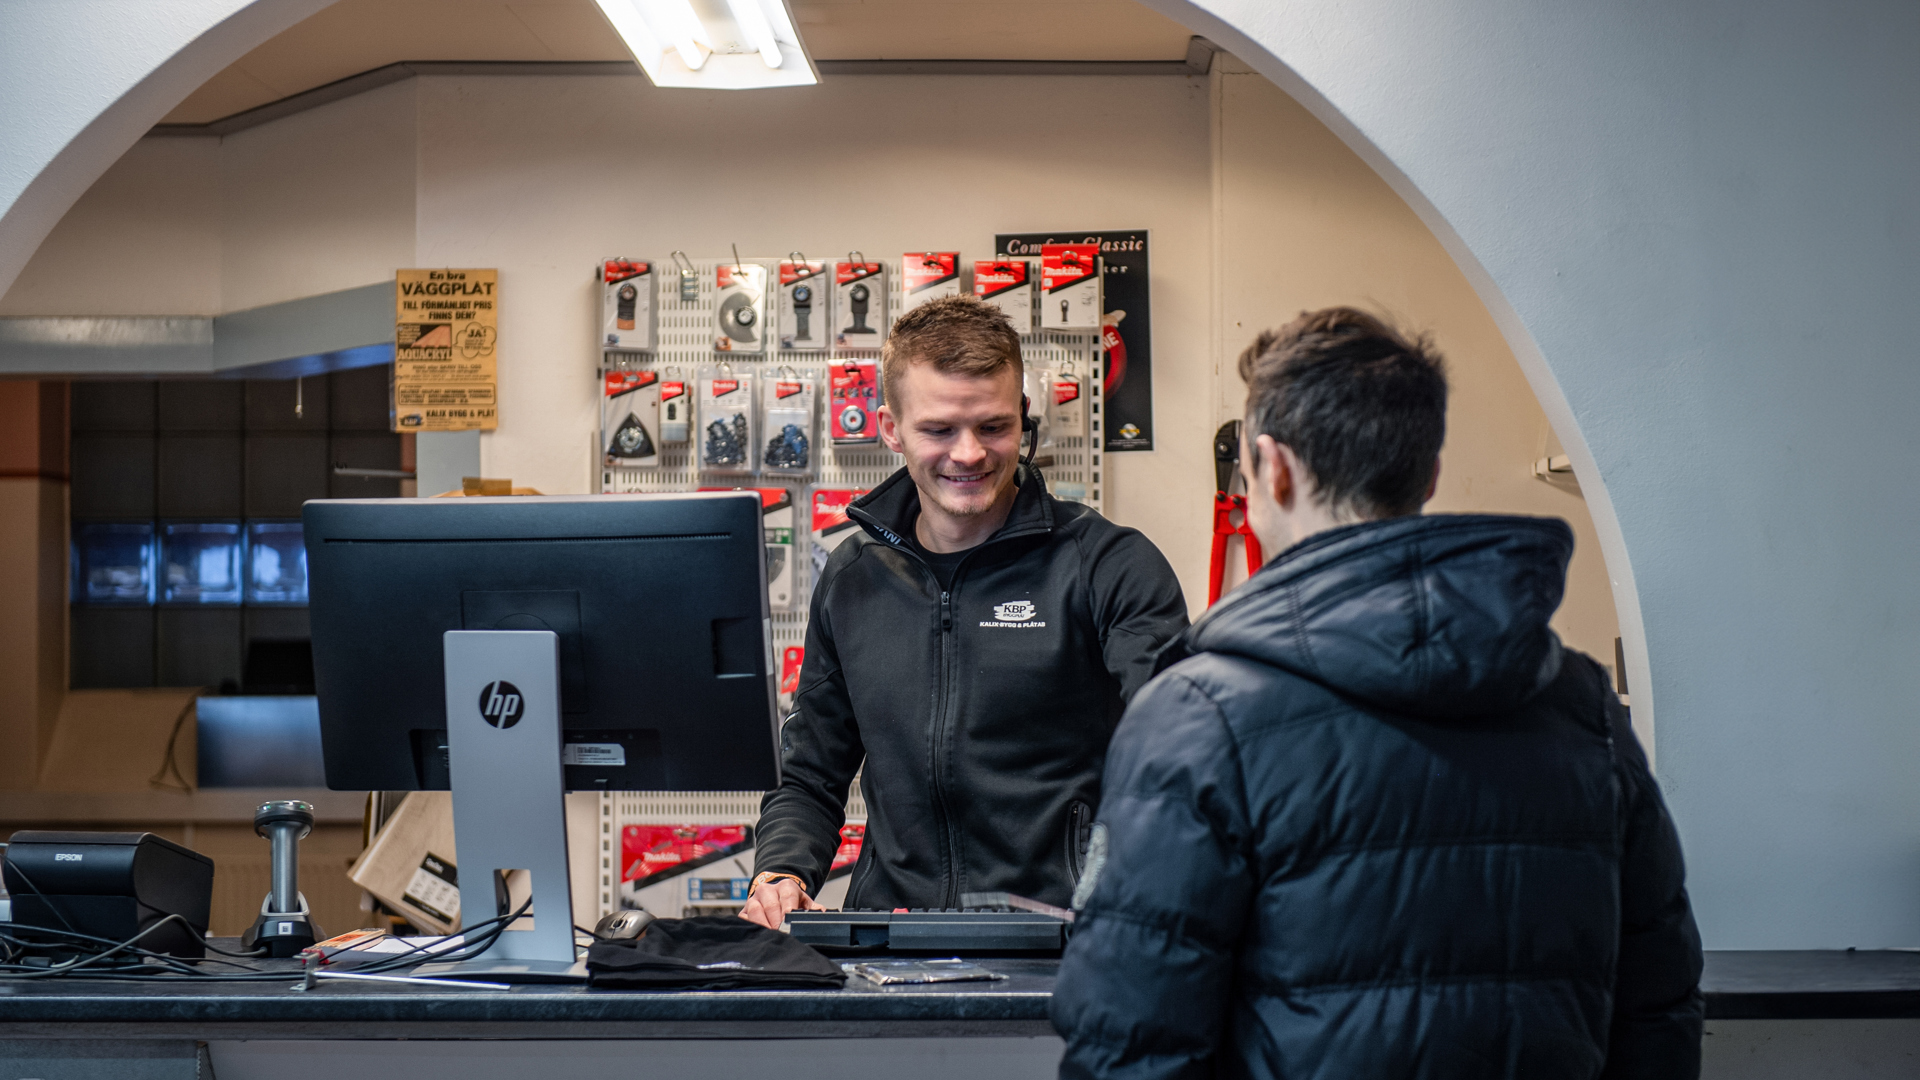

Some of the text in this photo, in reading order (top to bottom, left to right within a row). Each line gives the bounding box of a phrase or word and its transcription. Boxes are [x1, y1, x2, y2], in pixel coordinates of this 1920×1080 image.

[429, 271, 466, 280] En bra
[401, 281, 495, 296] VÄGGPLÅT
[403, 301, 418, 310] TILL
[473, 300, 493, 310] PRIS
[429, 311, 476, 320] FINNS DEN?
[468, 328, 487, 338] JA!
[426, 409, 446, 417] KALIX
[1003, 604, 1027, 614] KBP
[484, 680, 520, 730] hp
[54, 853, 83, 861] EPSON
